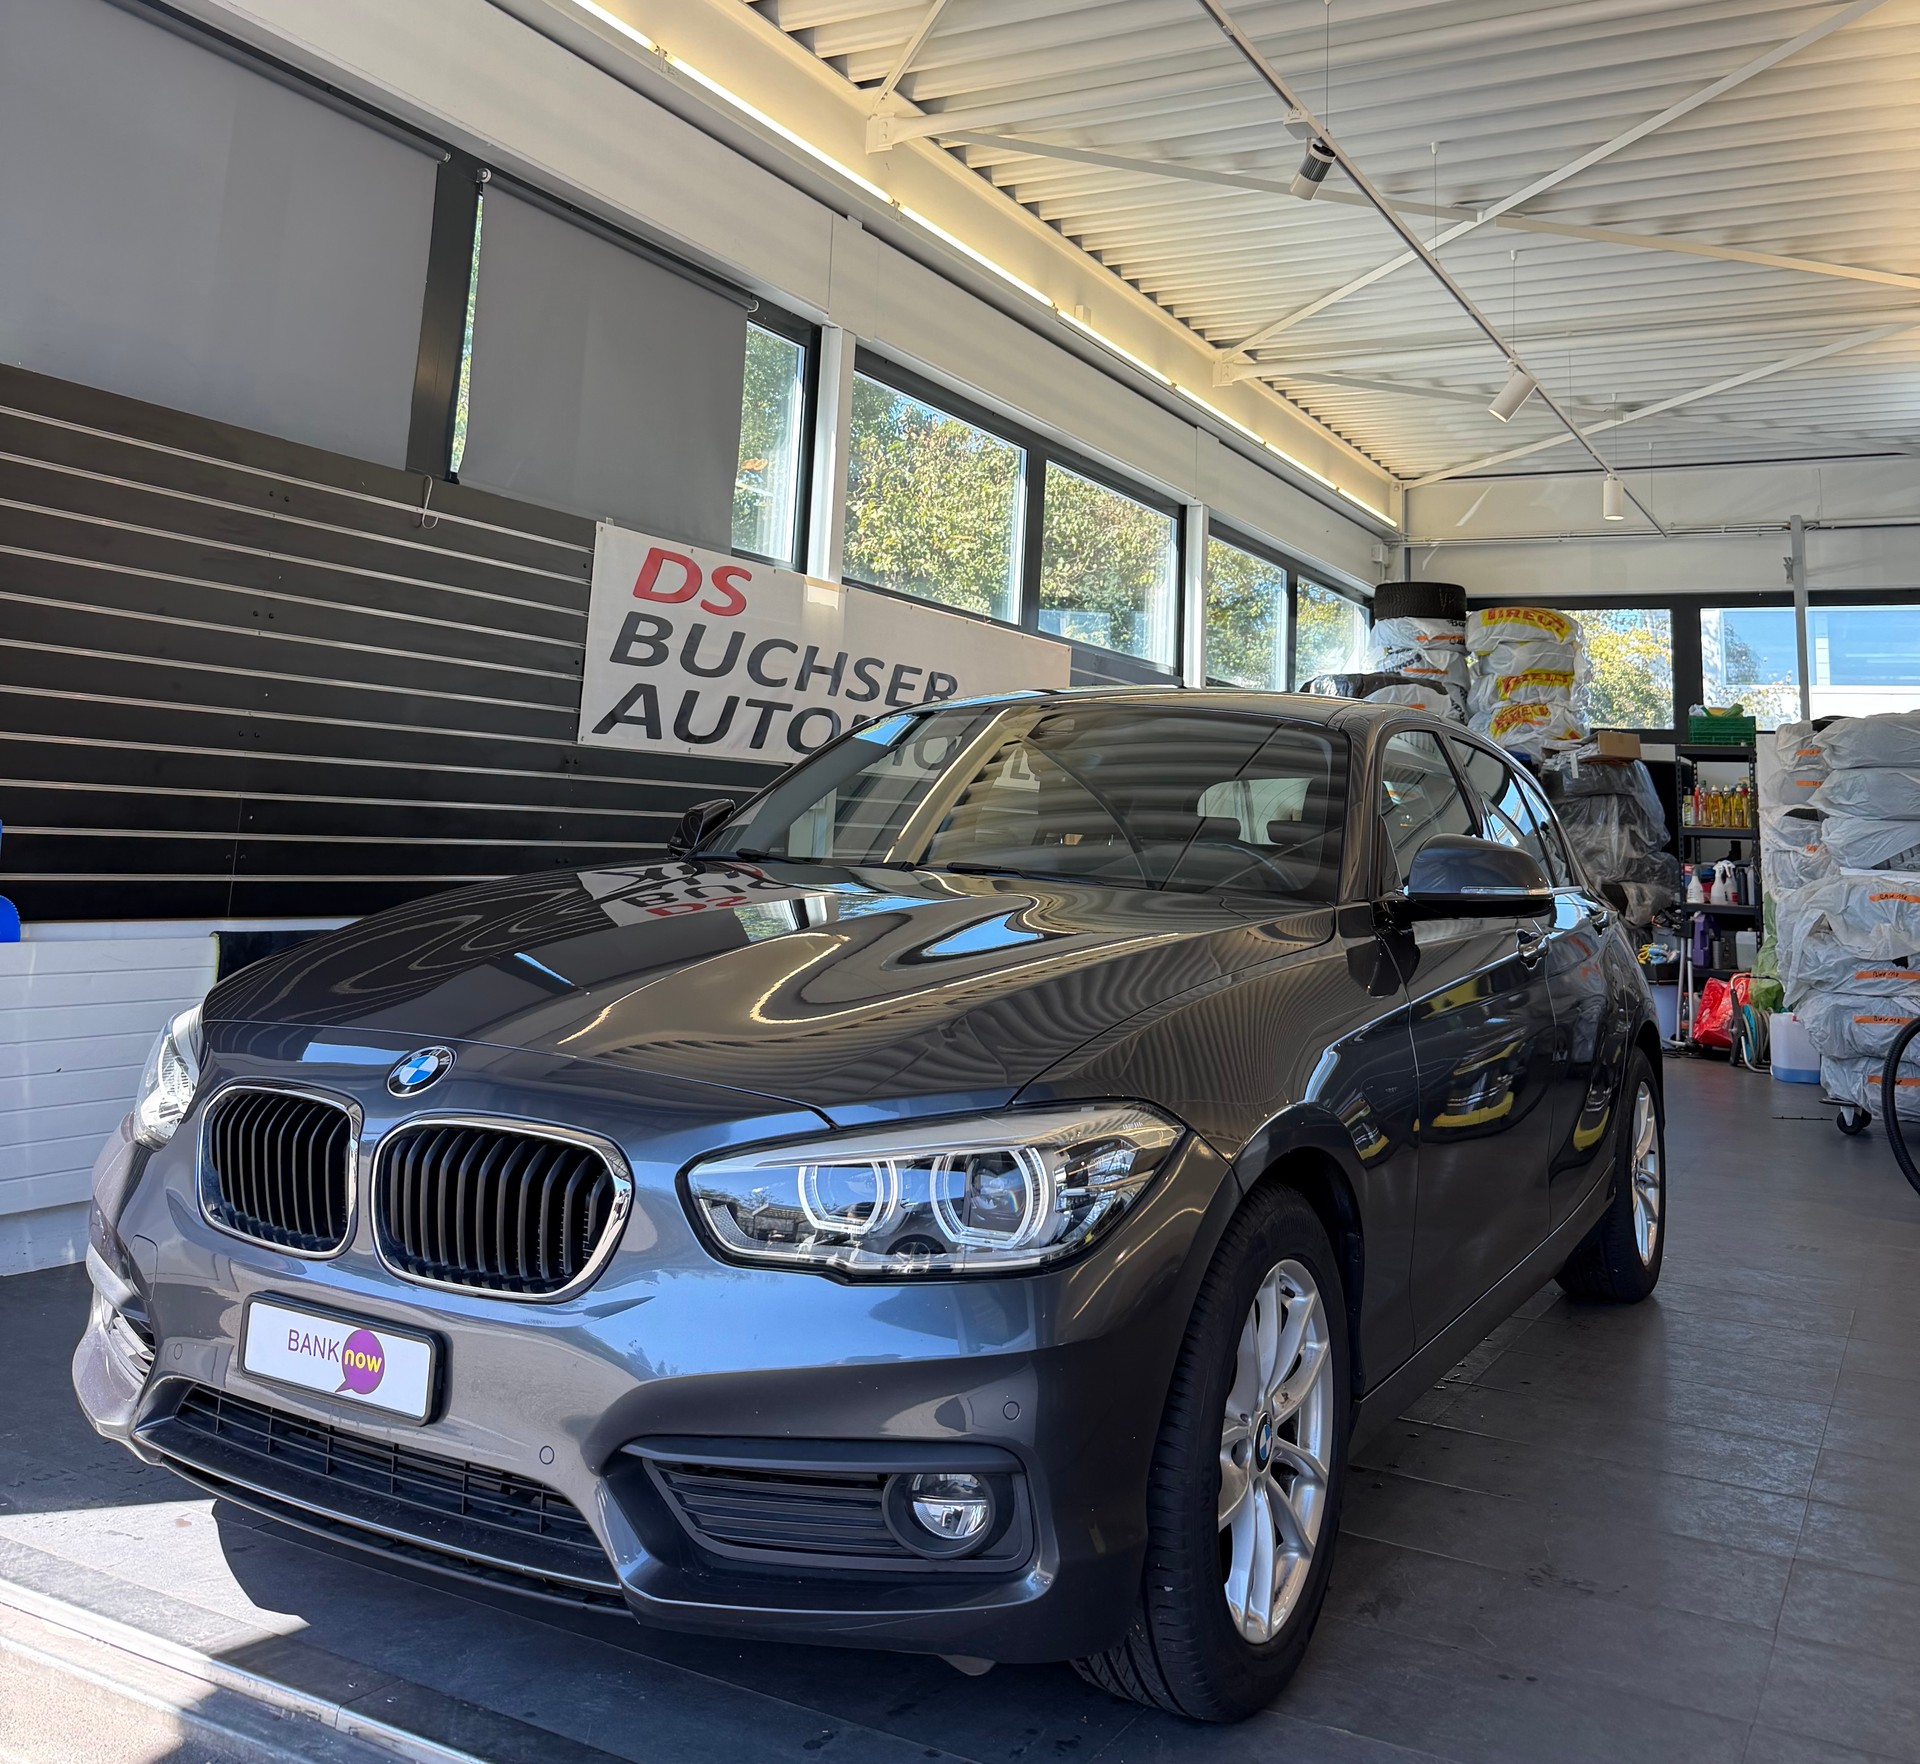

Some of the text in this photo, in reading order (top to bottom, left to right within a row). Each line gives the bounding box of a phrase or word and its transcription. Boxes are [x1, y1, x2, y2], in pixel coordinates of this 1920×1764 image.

[632, 547, 752, 617] DS
[609, 611, 958, 707] BUCHSER
[287, 1328, 383, 1374] BANK now
